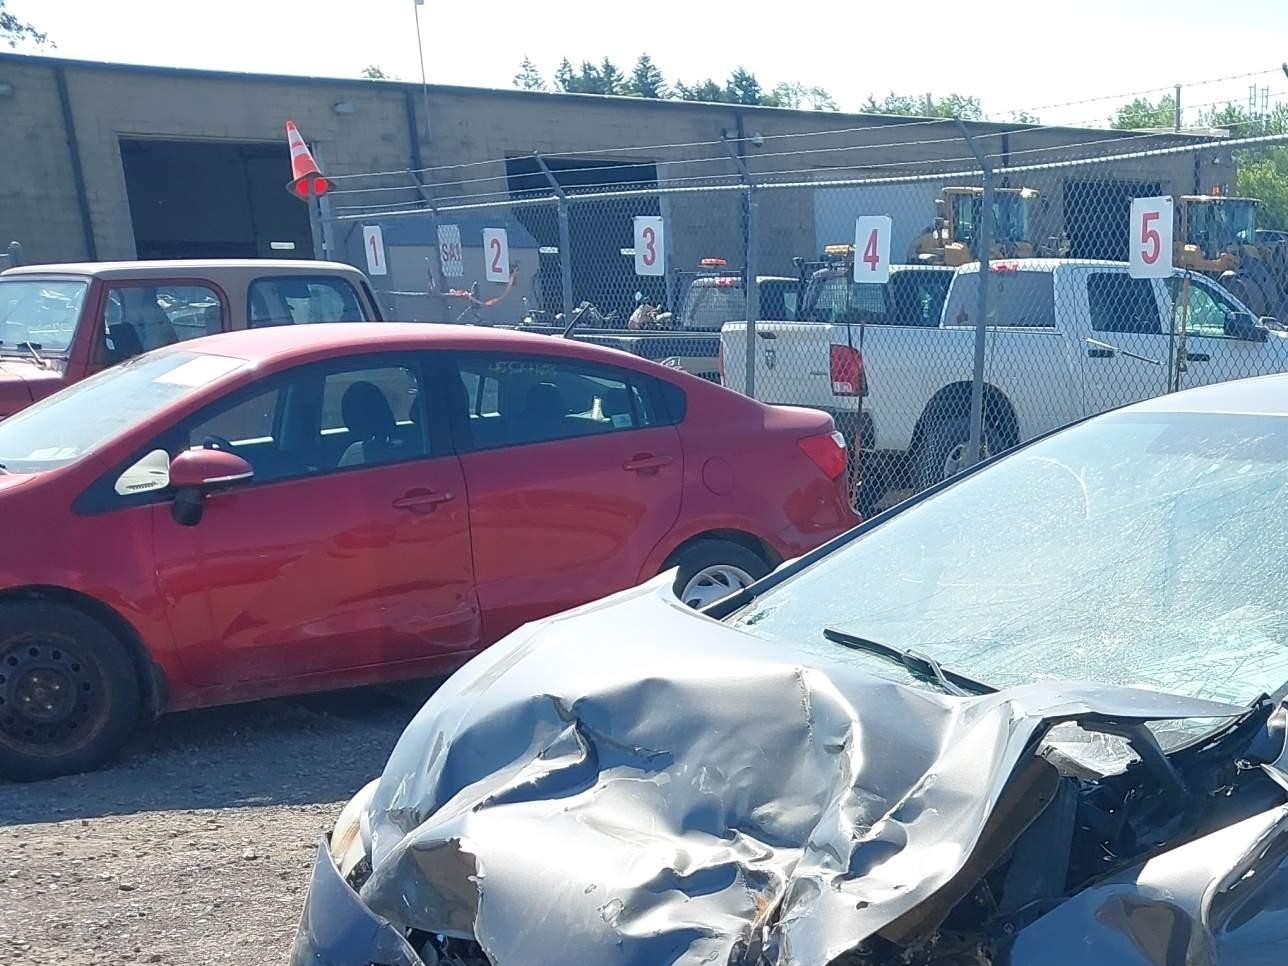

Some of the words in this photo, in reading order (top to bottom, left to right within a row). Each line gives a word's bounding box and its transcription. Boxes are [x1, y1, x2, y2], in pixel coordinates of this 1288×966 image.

[369, 235, 379, 267] 1
[490, 238, 503, 273] 2
[642, 226, 656, 266] 3
[863, 228, 880, 272] 4
[1141, 211, 1161, 265] 5
